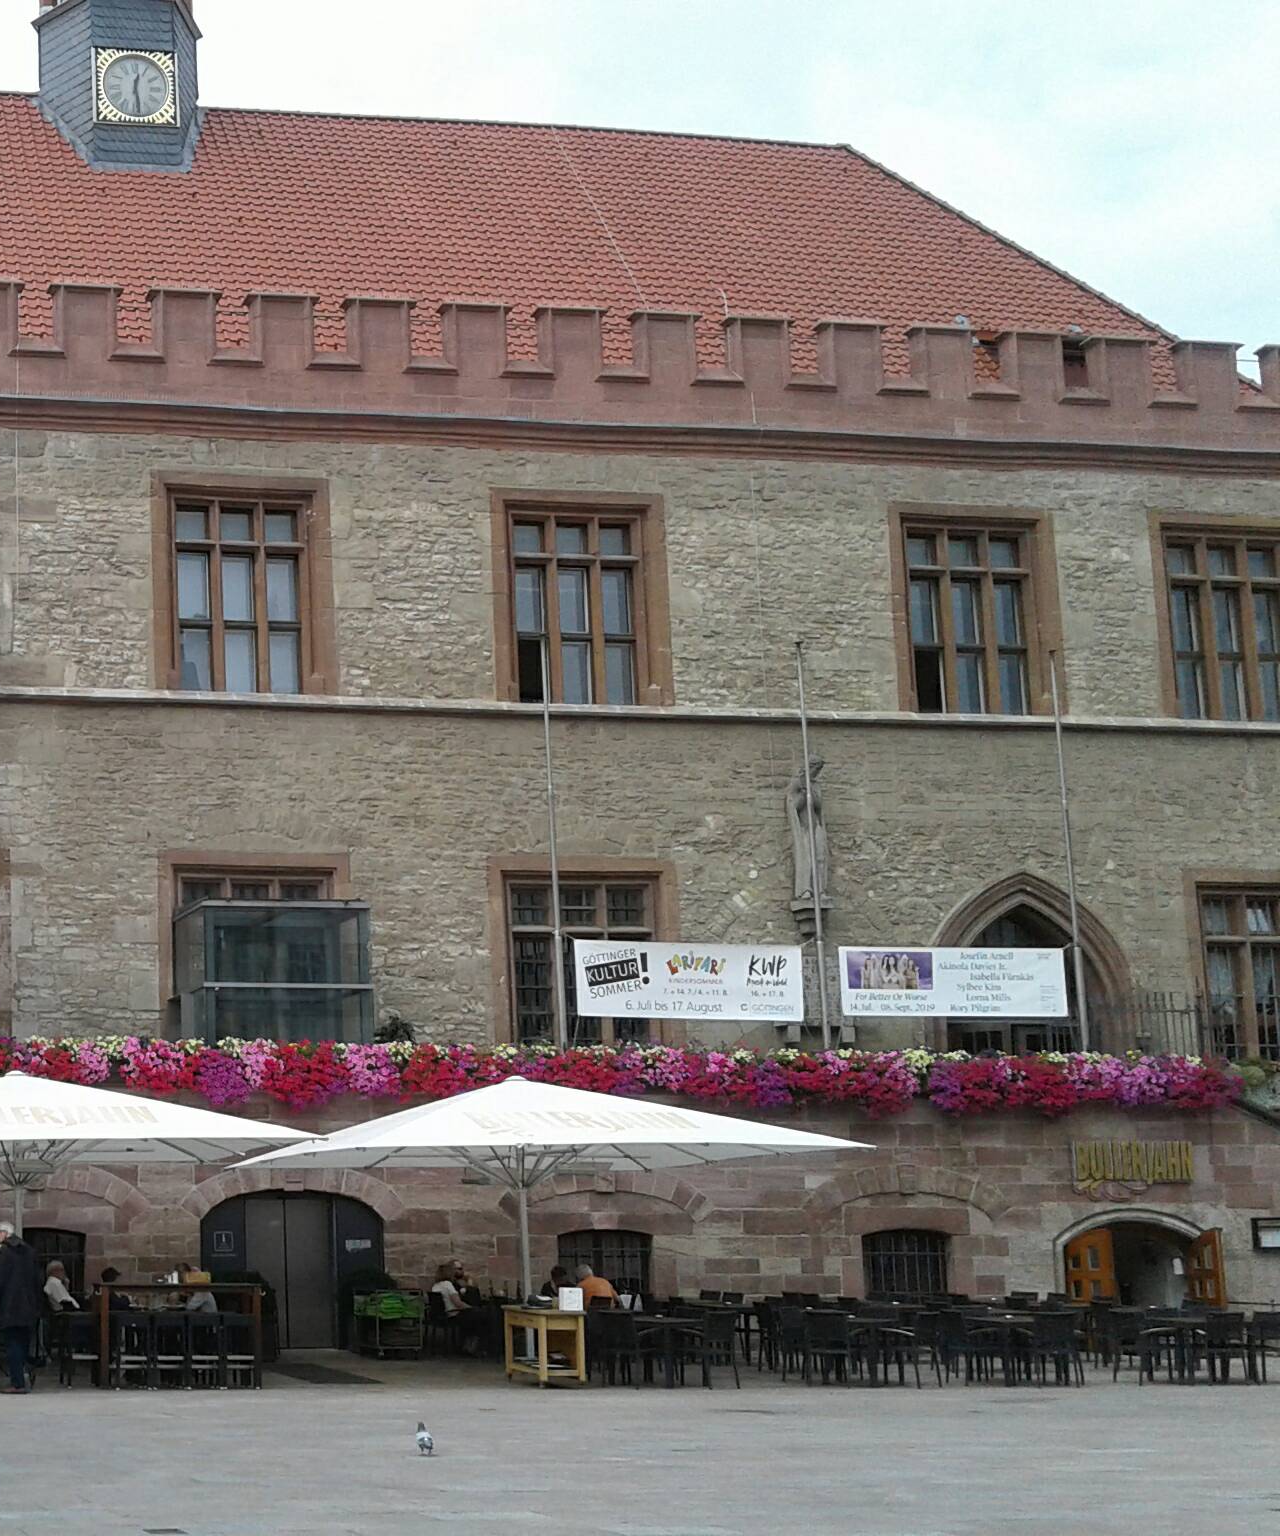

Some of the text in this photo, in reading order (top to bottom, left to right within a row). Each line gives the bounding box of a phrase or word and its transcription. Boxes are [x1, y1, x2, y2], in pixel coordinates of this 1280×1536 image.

[582, 948, 637, 965] GÖTTINGER
[748, 954, 788, 978] KWP
[590, 980, 642, 999] SOMMER
[637, 1000, 651, 1010] Juli
[654, 1000, 668, 1011] bis
[686, 1001, 724, 1014] August
